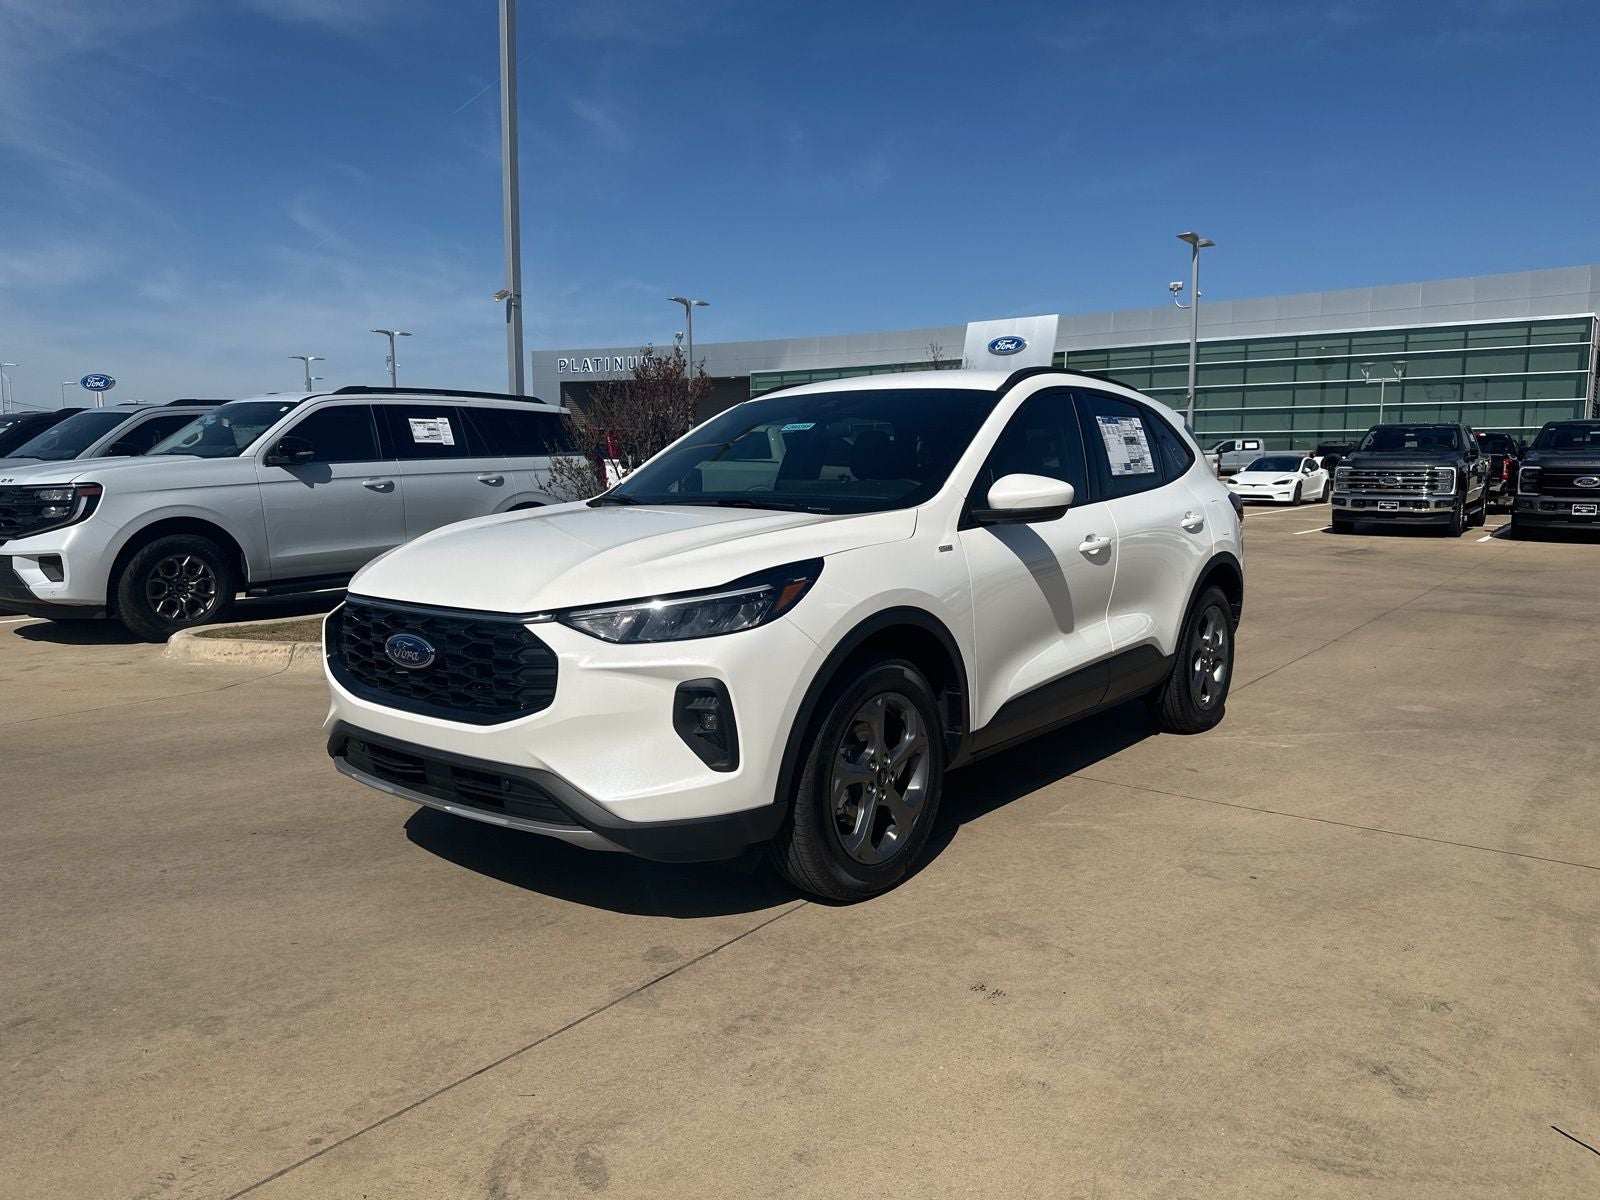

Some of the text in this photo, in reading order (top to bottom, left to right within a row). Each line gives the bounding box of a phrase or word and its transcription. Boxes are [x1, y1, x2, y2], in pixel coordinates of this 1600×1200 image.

[995, 339, 1018, 351] Ford
[86, 376, 106, 388] Ford
[393, 640, 424, 662] Ford
